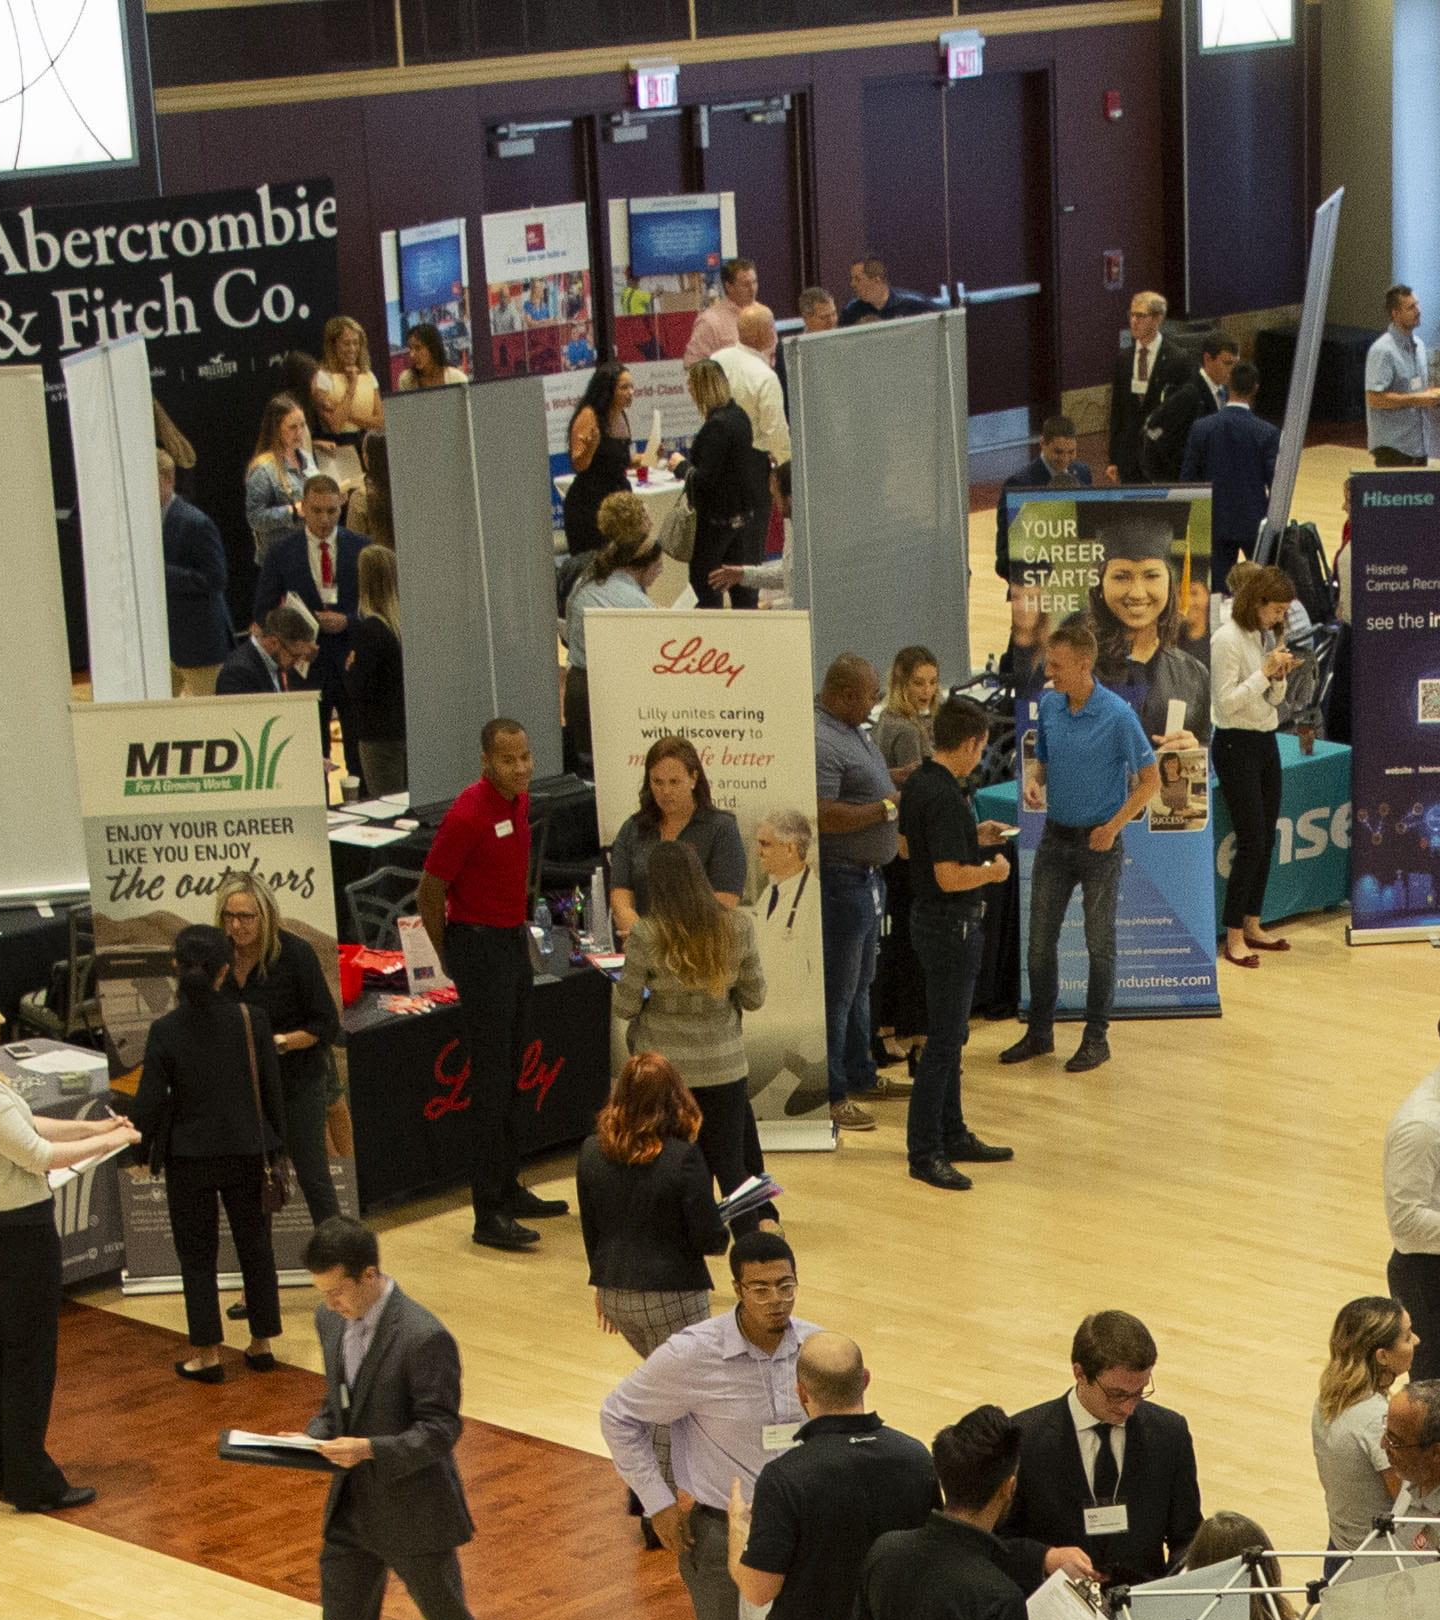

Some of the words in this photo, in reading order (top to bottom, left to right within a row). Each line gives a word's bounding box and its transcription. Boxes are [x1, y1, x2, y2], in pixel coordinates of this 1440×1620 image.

[52, 273, 201, 352] Fitch
[214, 268, 310, 329] Co.
[633, 383, 684, 398] orld-Class
[1363, 489, 1434, 508] Hisense
[1022, 519, 1078, 539] YOUR
[1023, 543, 1106, 563] CAREER
[1023, 567, 1101, 588] STARTS
[1366, 563, 1408, 575] Hisense
[1365, 578, 1409, 592] Campus
[1024, 594, 1080, 613] HERE
[1366, 616, 1394, 630] see
[1398, 613, 1425, 629] the
[652, 636, 746, 687] Lilly
[637, 706, 667, 724] Lilly
[671, 707, 715, 722] unites
[719, 706, 765, 726] caring
[641, 724, 672, 740] with
[676, 725, 745, 744] discovery
[748, 728, 763, 740] to
[126, 738, 239, 778] MTD
[722, 747, 775, 768] better
[162, 780, 201, 795] Growing
[718, 776, 767, 789] around
[106, 823, 163, 843] ENJOY
[169, 820, 219, 840] YOUR
[224, 817, 294, 837] CAREER
[108, 848, 148, 865] LIKE
[152, 846, 189, 863] YOU
[195, 843, 251, 862] ENJOY
[107, 871, 165, 902] the
